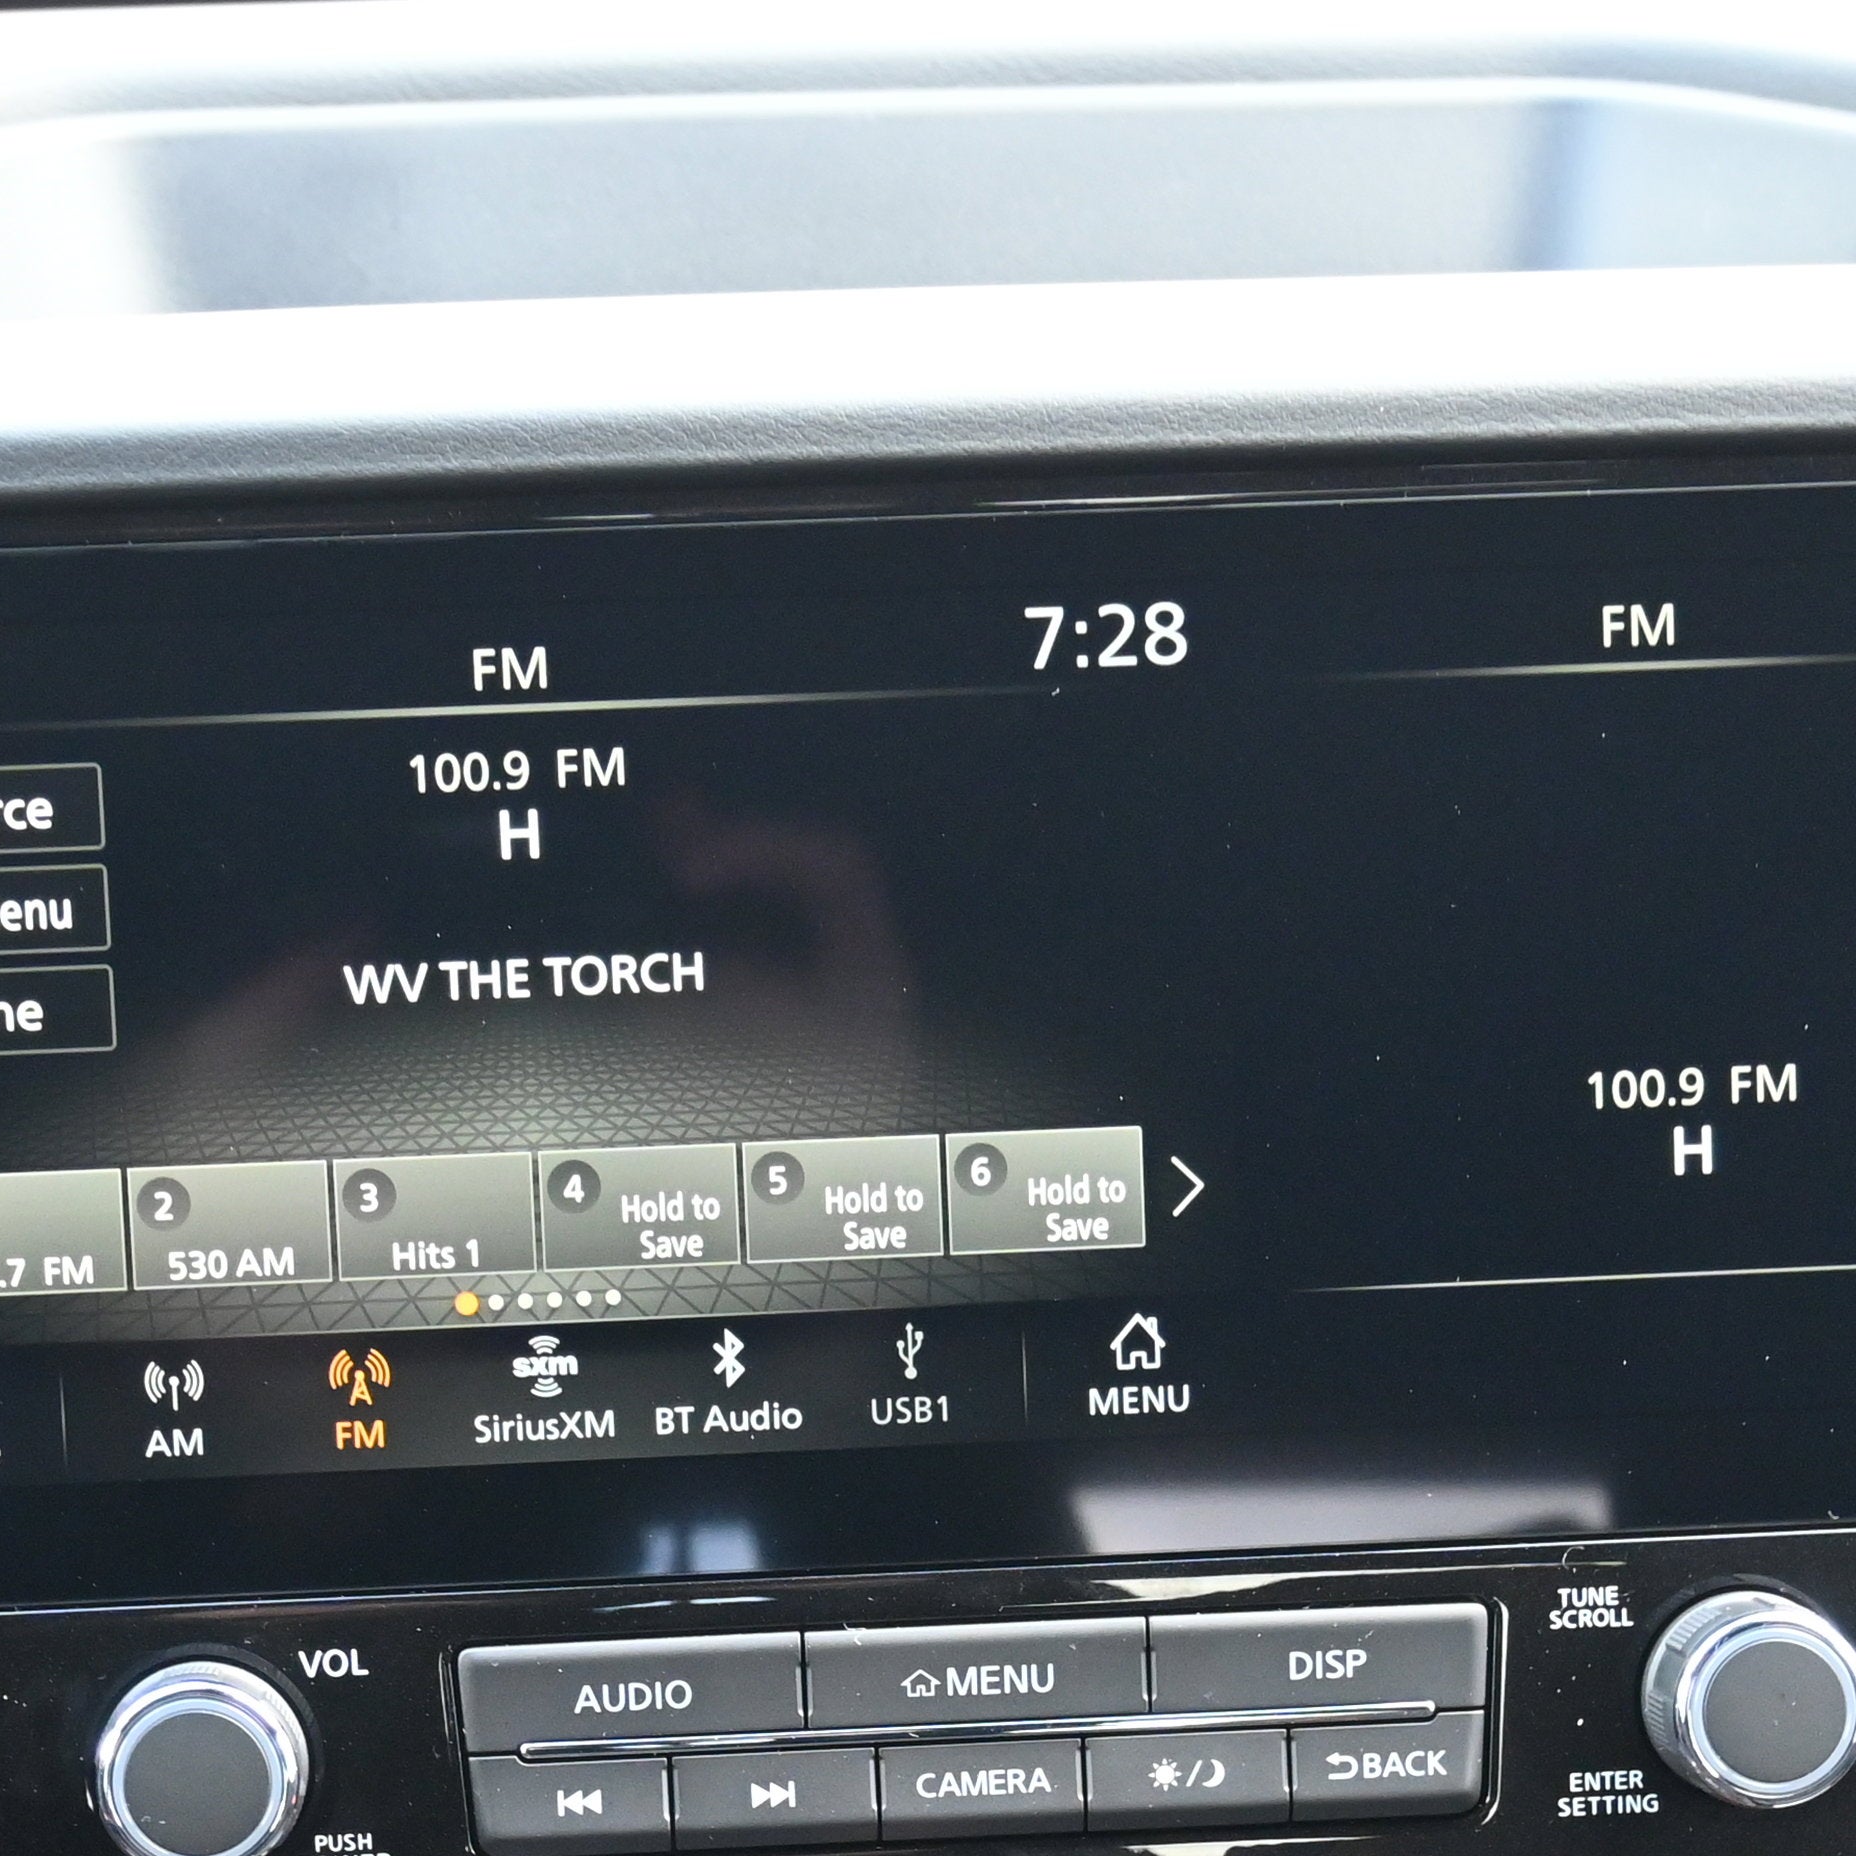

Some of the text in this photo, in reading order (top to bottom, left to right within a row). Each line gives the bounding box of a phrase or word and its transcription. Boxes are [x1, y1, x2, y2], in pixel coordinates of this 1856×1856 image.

[1024, 601, 1188, 670] 7:28
[1602, 602, 1675, 648] FM
[472, 645, 548, 692] FM
[409, 746, 626, 794] 100.9 FM
[498, 807, 541, 861] H
[342, 951, 705, 1005] WV THE TORCH
[1587, 1062, 1797, 1110] 100.9 FM
[1673, 1124, 1714, 1176] H
[768, 1165, 788, 1196] 5
[970, 1156, 992, 1187] 6
[359, 1182, 379, 1213] 3
[562, 1174, 585, 1204] 4
[824, 1181, 924, 1215] Hold to
[1027, 1173, 1127, 1207] Hold to
[153, 1191, 174, 1222] 2
[620, 1189, 721, 1224] Hold to
[843, 1221, 907, 1251] Save
[1045, 1212, 1110, 1243] Save
[391, 1238, 479, 1271] Hits 1
[639, 1229, 704, 1260] Save
[43, 1254, 95, 1286] FM
[168, 1246, 295, 1281] 530 AM
[510, 1353, 581, 1378] sxm
[871, 1395, 948, 1426] USB1
[1088, 1383, 1190, 1416] MENU
[473, 1409, 616, 1444] SiriusXM
[655, 1400, 803, 1436] BT Audio
[145, 1427, 204, 1458] AM
[335, 1419, 385, 1450] FM
[1556, 1585, 1620, 1609] TUNE
[1548, 1603, 1635, 1630] SCROLL
[297, 1648, 370, 1679] VOL
[946, 1662, 1055, 1697] MENU
[1288, 1648, 1368, 1681] DISP
[573, 1679, 693, 1714] AUDIO
[1362, 1749, 1448, 1779] BACK
[915, 1767, 1052, 1799] CAMERA
[1569, 1769, 1644, 1793] ENTER
[1557, 1789, 1659, 1818] SETTING
[314, 1832, 375, 1856] PUSH
